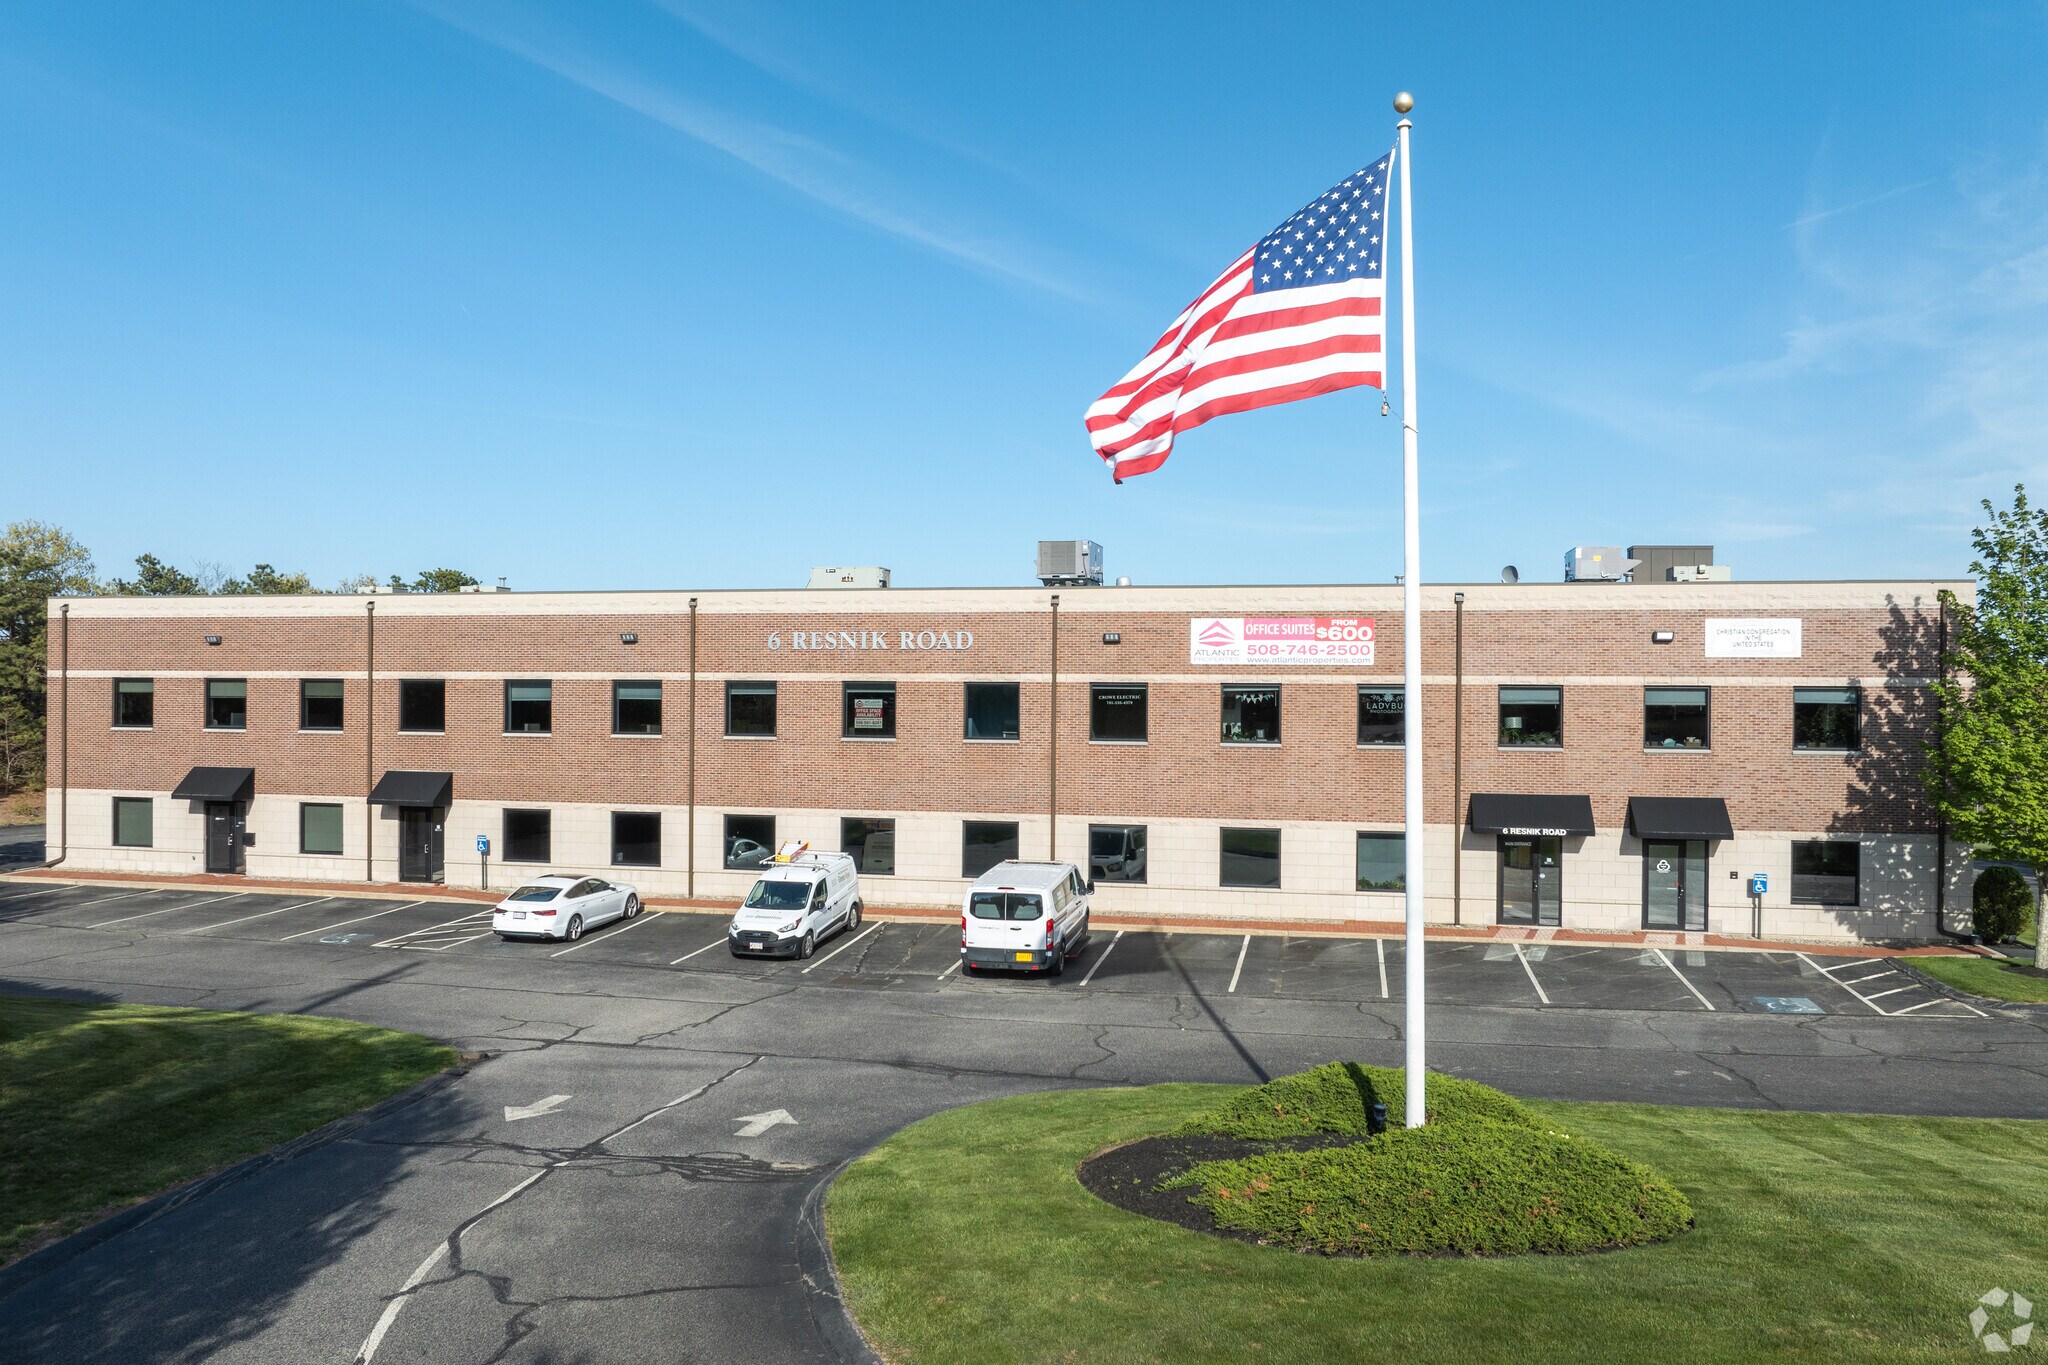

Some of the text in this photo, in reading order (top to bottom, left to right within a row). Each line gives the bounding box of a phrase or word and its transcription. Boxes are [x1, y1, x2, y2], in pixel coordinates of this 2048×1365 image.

[1245, 623, 1315, 635] OFFICE SUITES
[1316, 626, 1373, 641] $600
[767, 631, 974, 650] 6 RESNIK ROAD
[1247, 644, 1371, 656] 508-746-2500
[1502, 827, 1567, 836] 6 RESNIK ROAD
